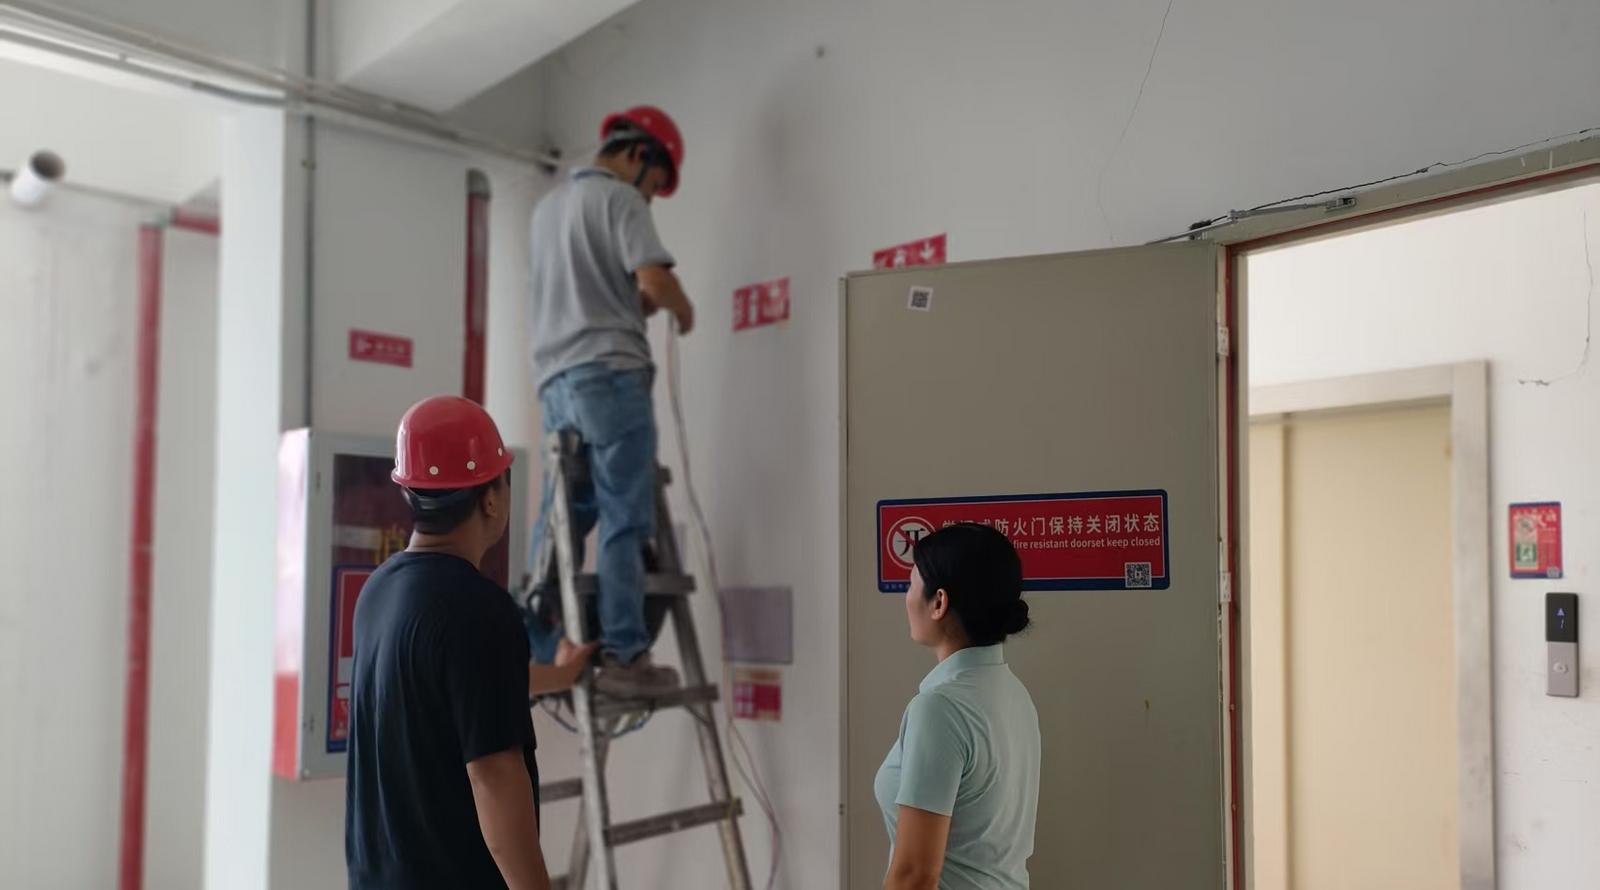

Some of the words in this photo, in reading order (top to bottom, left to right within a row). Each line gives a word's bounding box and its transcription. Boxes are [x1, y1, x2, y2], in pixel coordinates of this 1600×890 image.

[942, 512, 1160, 538] 防火门保持关闭状态
[1013, 539, 1029, 549] fire
[1029, 538, 1068, 550] resistant
[1070, 538, 1105, 549] doorset
[1107, 537, 1129, 549] keep
[1130, 536, 1160, 547] closed
